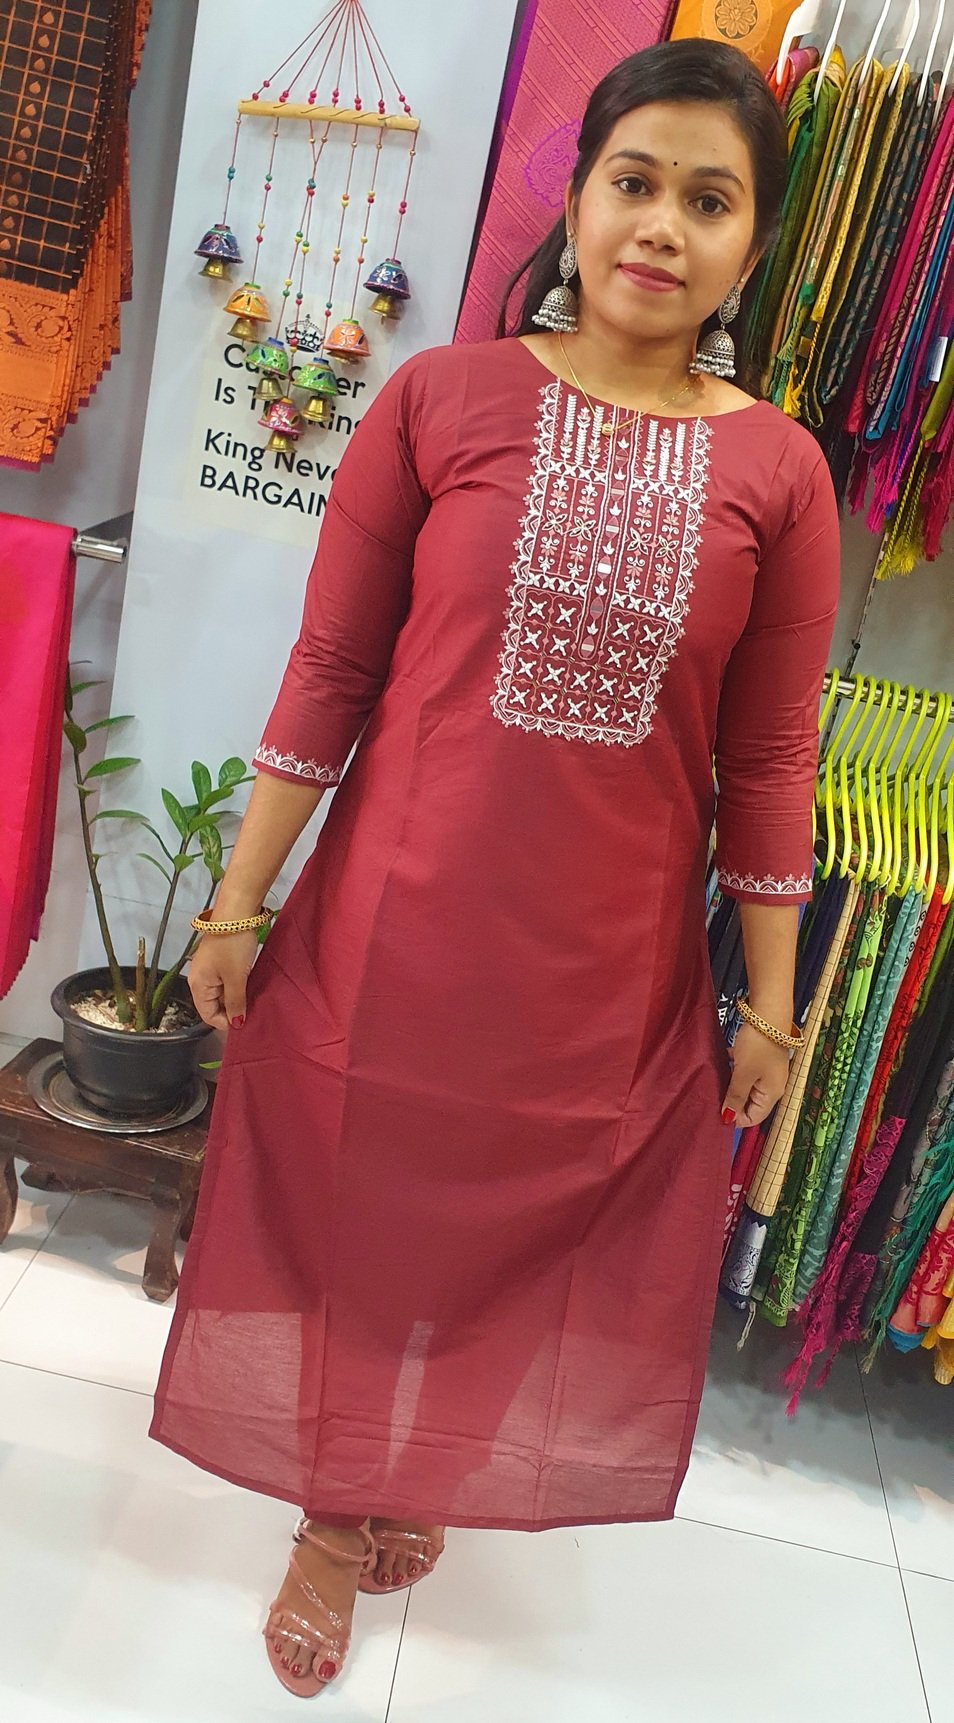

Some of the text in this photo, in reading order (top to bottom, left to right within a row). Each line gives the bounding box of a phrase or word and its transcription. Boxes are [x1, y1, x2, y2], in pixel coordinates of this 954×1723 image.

[215, 378, 236, 404] Is
[204, 428, 338, 481] King Nev
